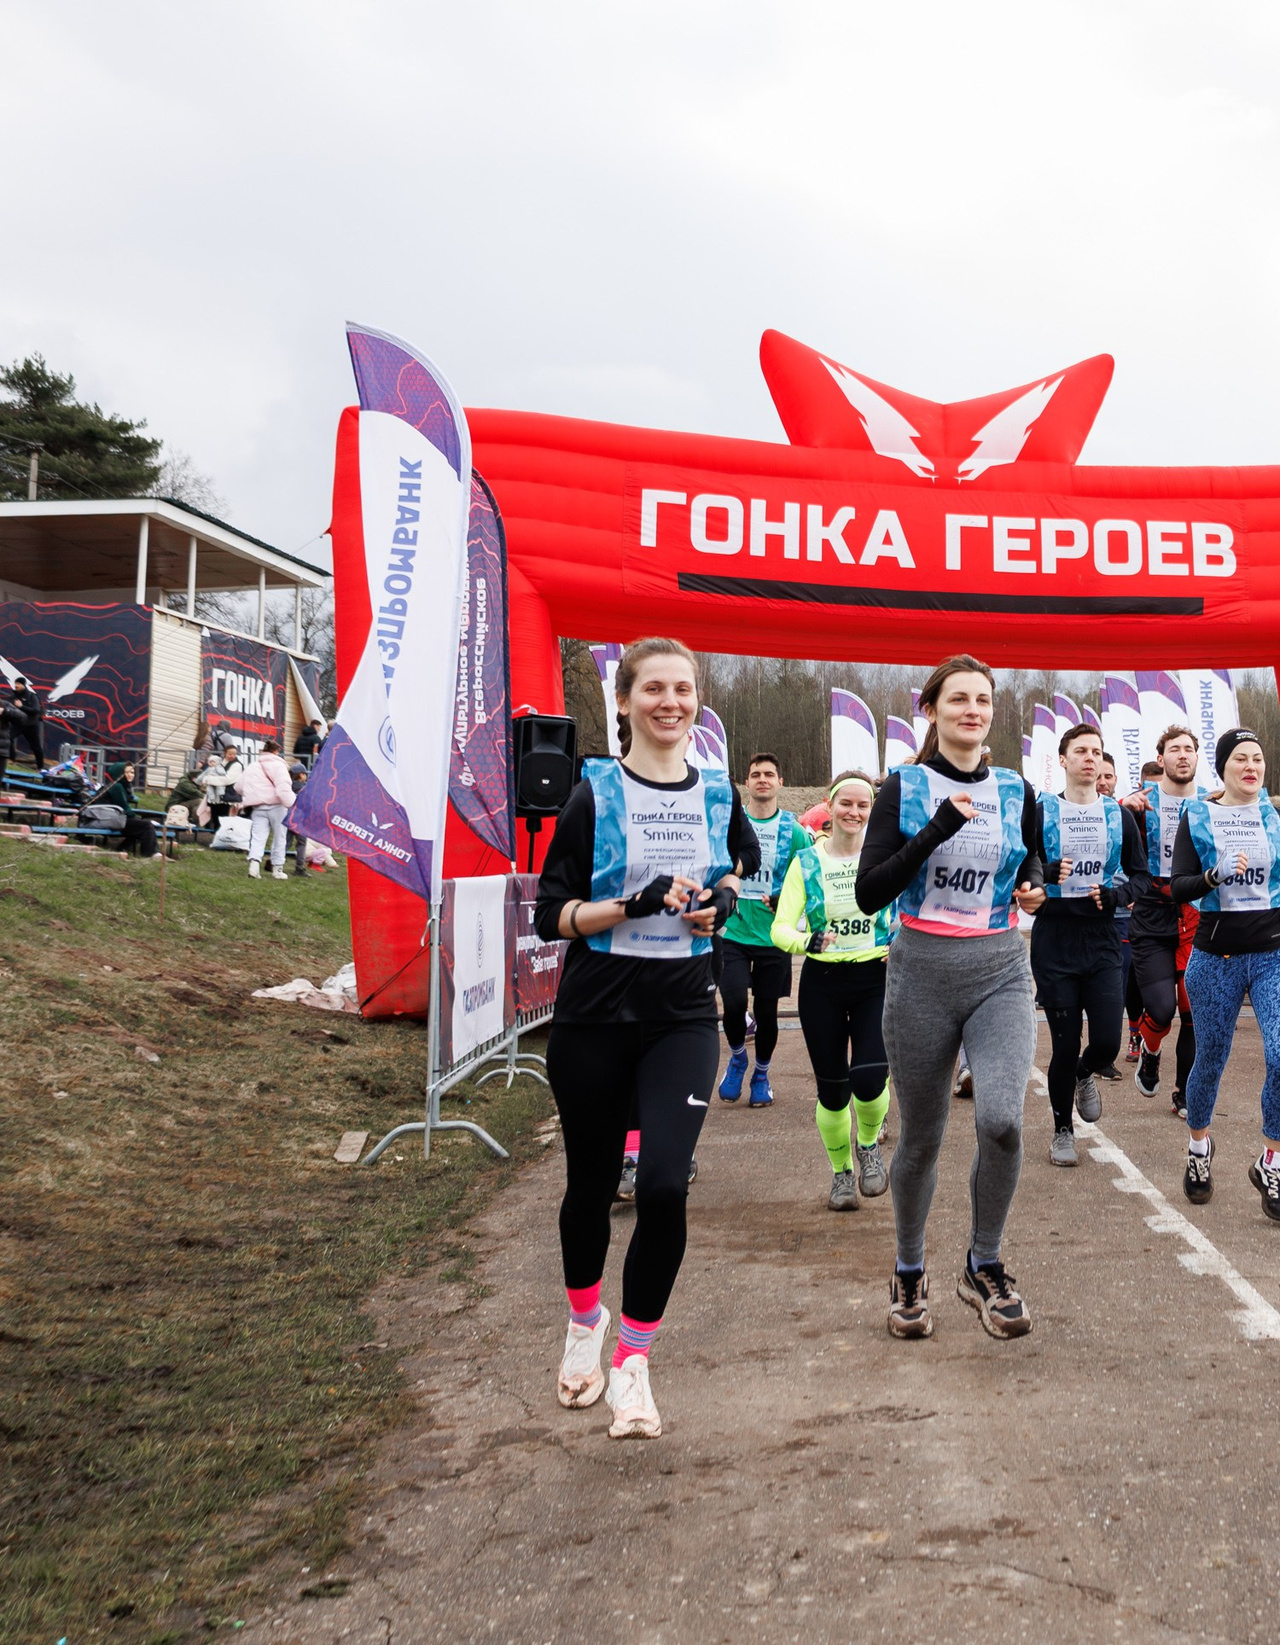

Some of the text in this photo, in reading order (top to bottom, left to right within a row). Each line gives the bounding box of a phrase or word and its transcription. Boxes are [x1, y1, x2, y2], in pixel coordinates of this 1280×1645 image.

[640, 488, 1237, 578] ГОНКА ГЕРОЕВ
[211, 667, 275, 720] ГОНКА
[45, 710, 85, 718] ЕРОЕВ
[971, 801, 997, 812] ЕРОЕВ
[632, 813, 702, 822] ГОНКА ГЕРОЕВ
[968, 814, 989, 827] nex
[643, 828, 694, 841] Sminex
[1068, 825, 1098, 833] Sminex
[1222, 828, 1256, 837] Sminex
[825, 870, 846, 879] ГОНКА
[933, 866, 990, 894] 5407
[832, 880, 856, 891] Smin
[829, 918, 872, 936] 5398
